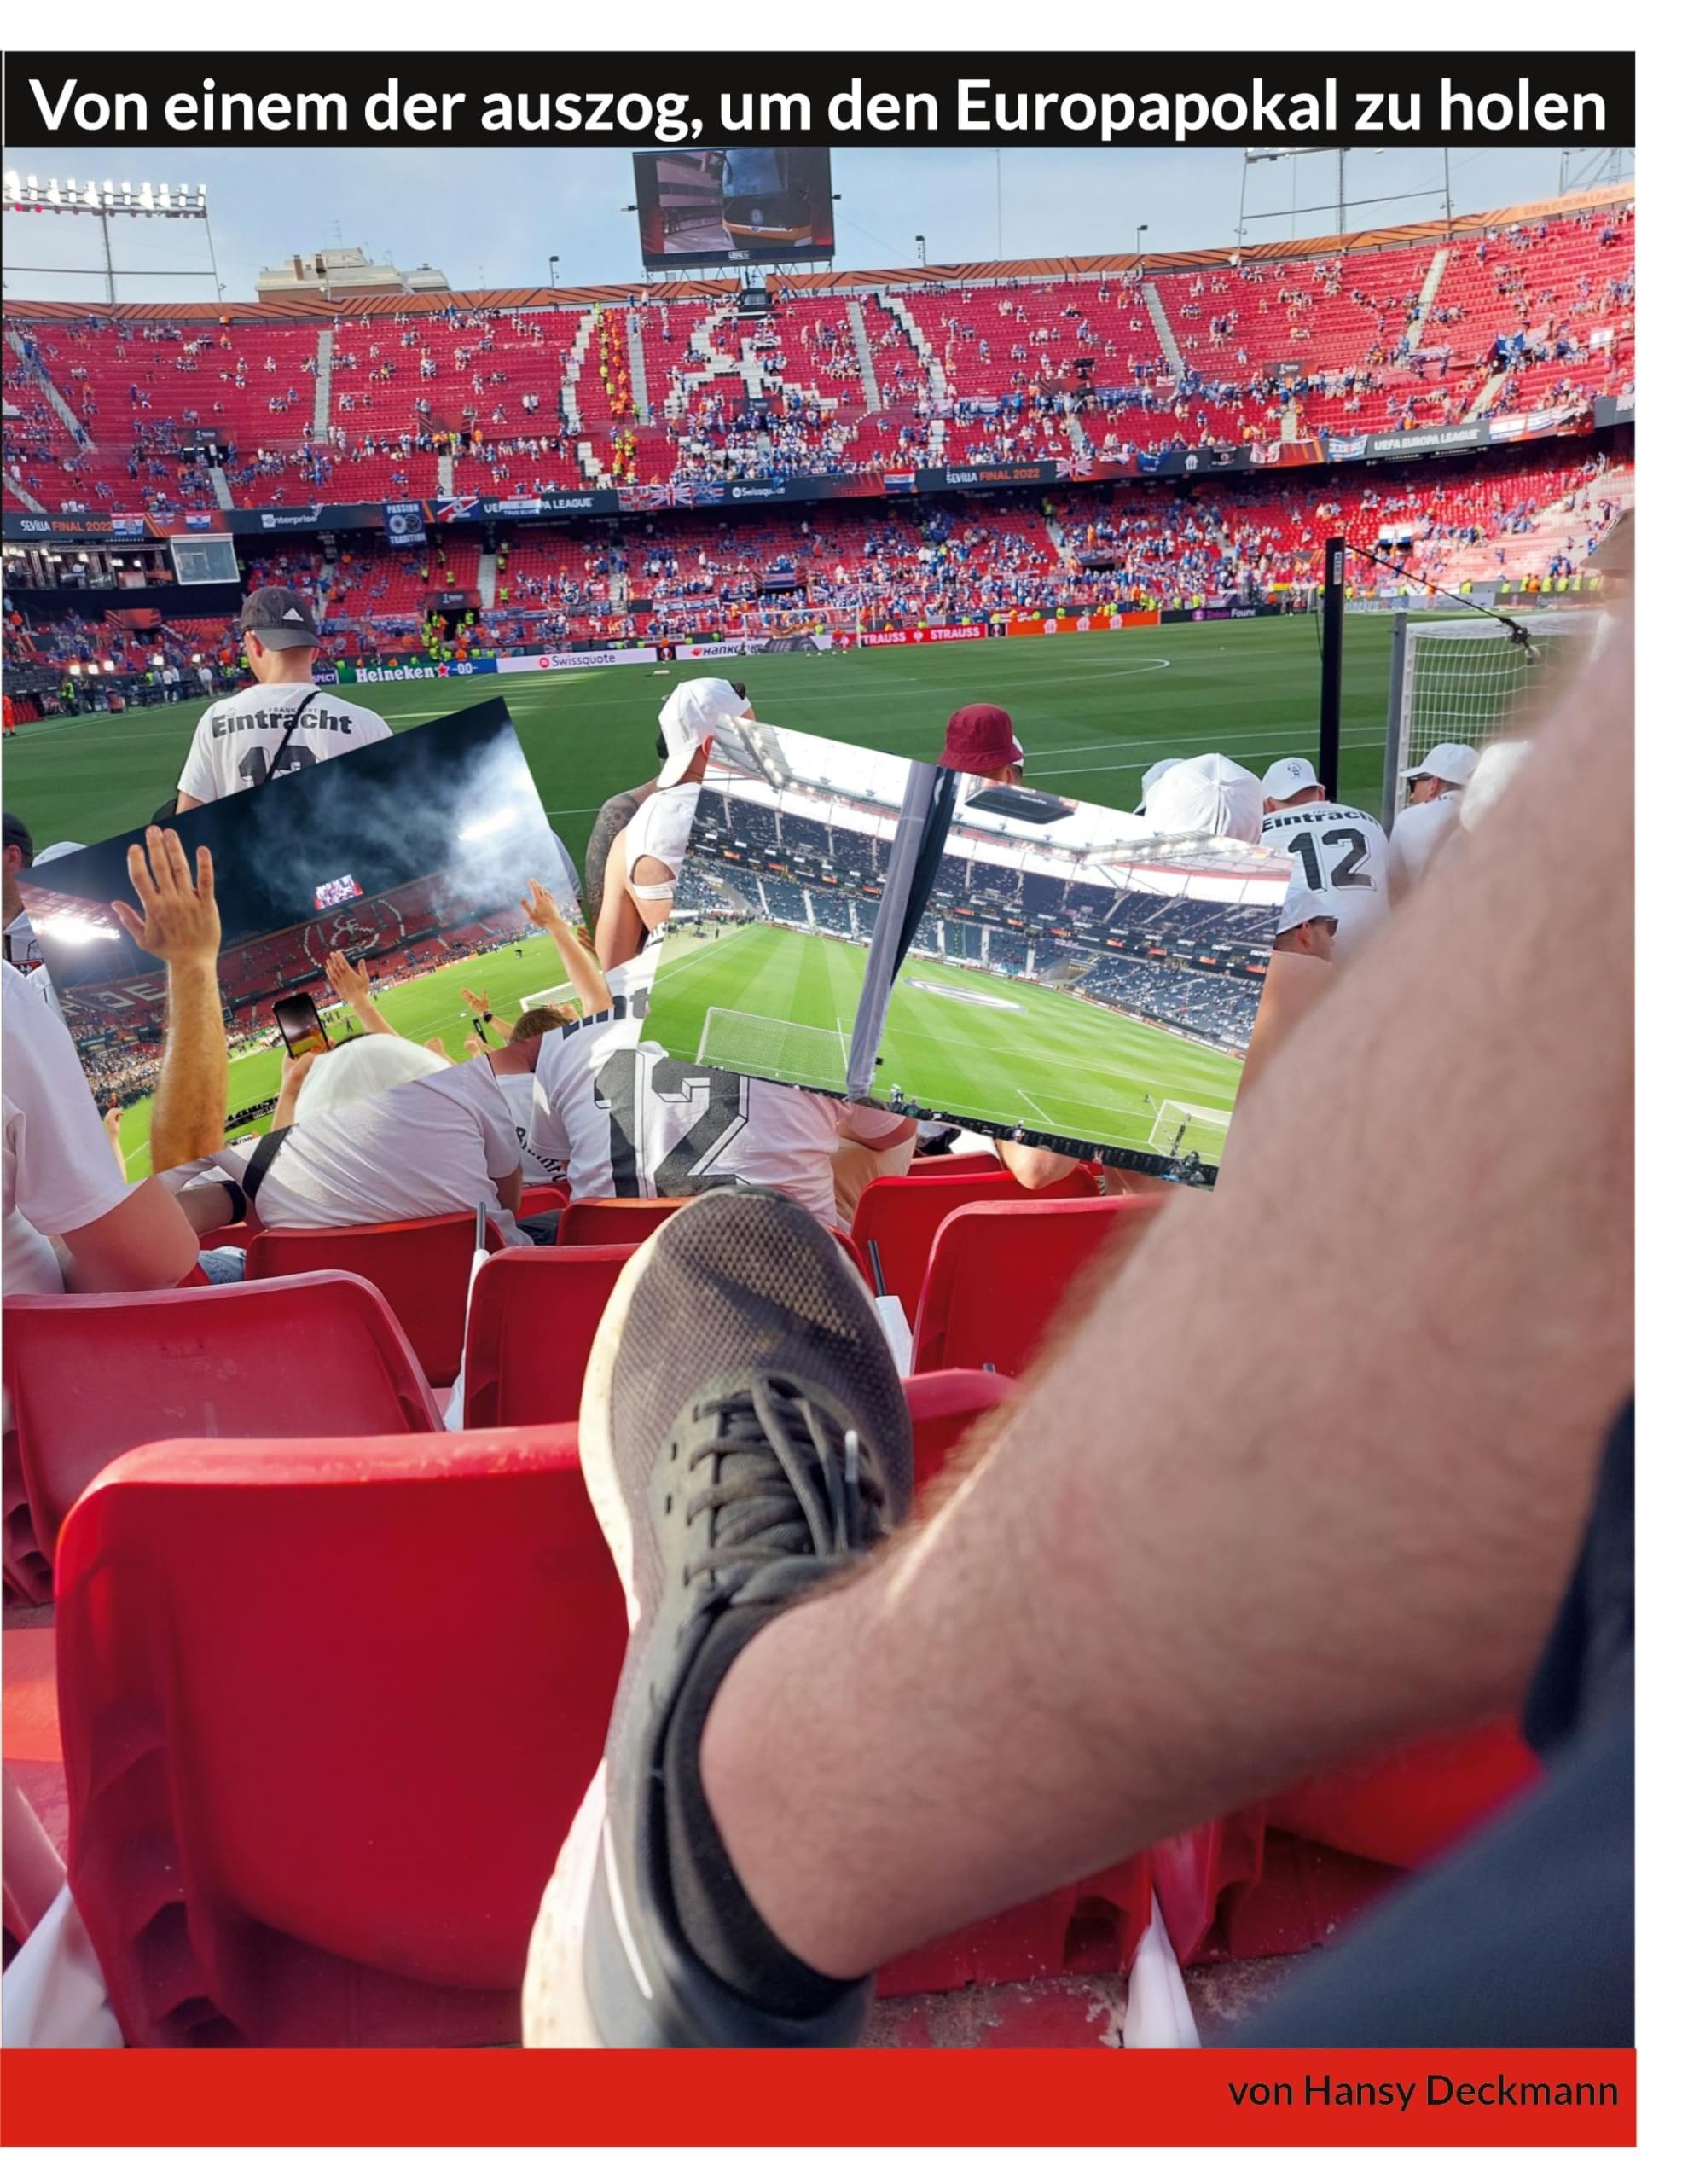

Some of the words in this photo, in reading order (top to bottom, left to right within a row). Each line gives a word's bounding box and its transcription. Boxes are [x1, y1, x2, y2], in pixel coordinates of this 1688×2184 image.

[1374, 438, 1401, 451] UEFA
[1401, 433, 1439, 449] EUROPA
[1440, 428, 1480, 444] LEAGUE
[979, 469, 1012, 483] FINAL
[1013, 468, 1041, 479] 2022
[552, 497, 594, 510] LEAGUE
[51, 520, 84, 532] FINAL
[85, 520, 113, 531] 2022
[931, 623, 981, 640] STRAUSS
[551, 653, 616, 669] Swissquote
[355, 665, 436, 683] Heineken
[212, 710, 353, 739] Eintracht
[1287, 828, 1377, 892] 12
[594, 1048, 752, 1198] 12
